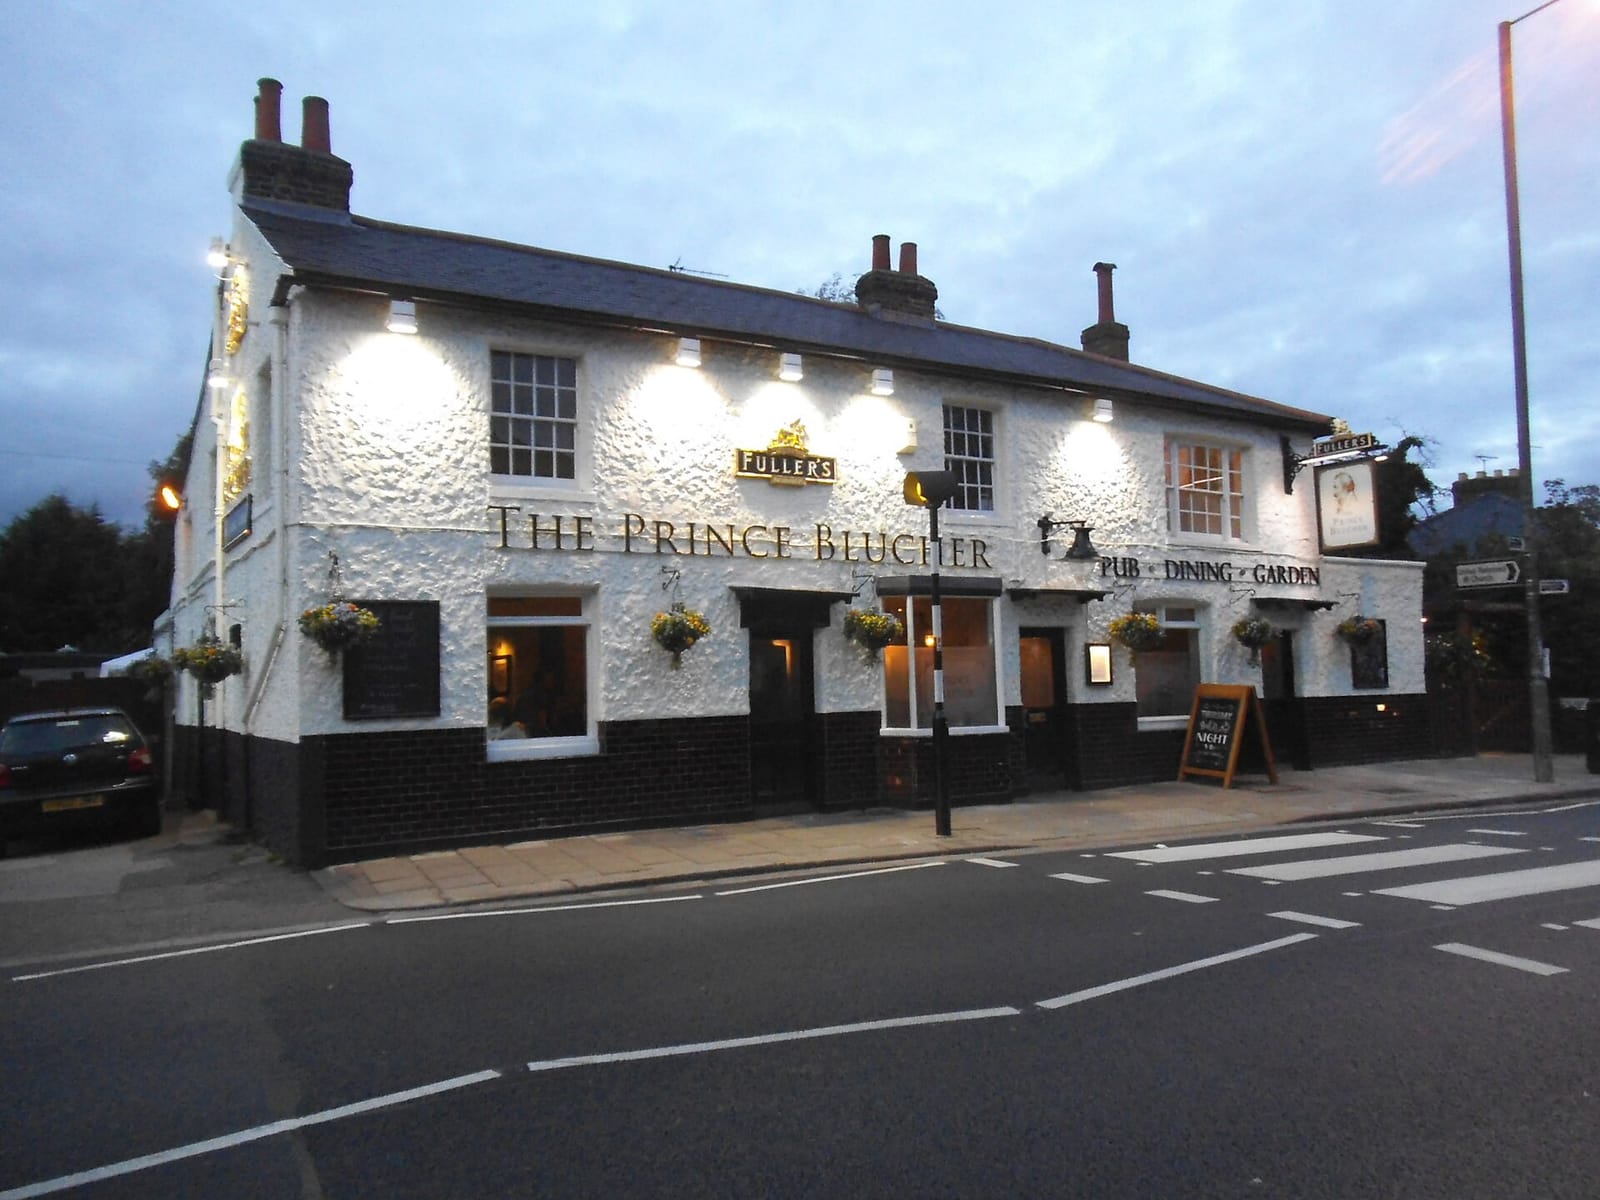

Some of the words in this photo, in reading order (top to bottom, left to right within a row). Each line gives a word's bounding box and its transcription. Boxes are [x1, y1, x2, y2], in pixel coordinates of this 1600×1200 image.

[742, 452, 831, 478] FULLER'S
[486, 505, 594, 550] THE
[623, 513, 790, 559] PRINCE
[814, 523, 992, 568] BLUCHER
[1101, 556, 1140, 577] PUB
[1164, 560, 1232, 582] DINING
[1253, 564, 1320, 585] GARDEN
